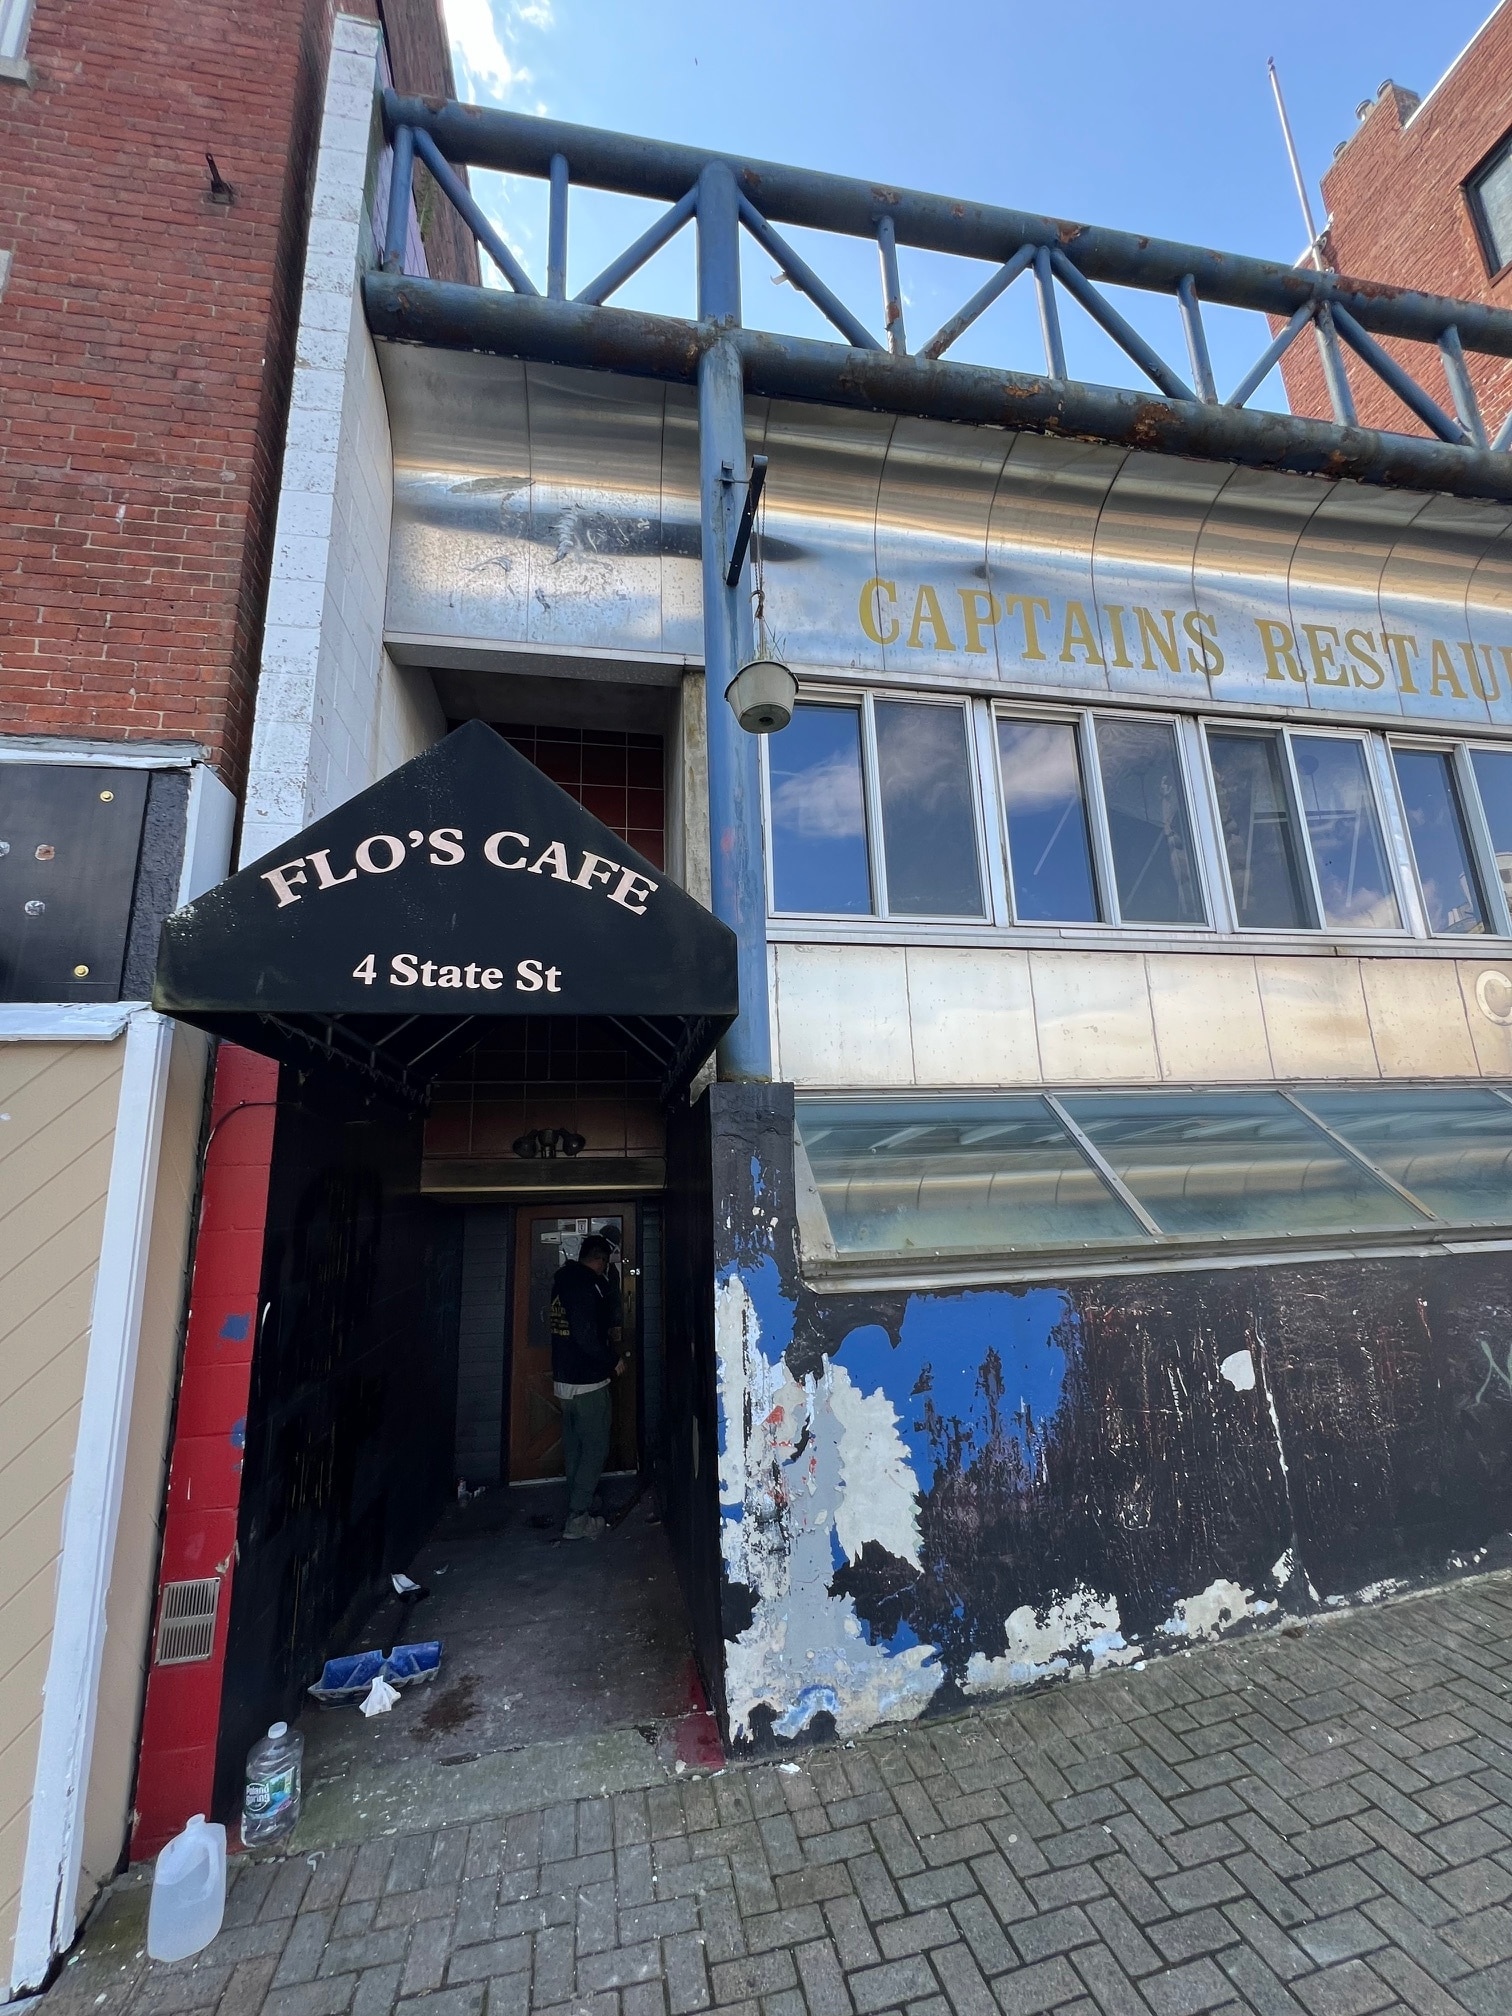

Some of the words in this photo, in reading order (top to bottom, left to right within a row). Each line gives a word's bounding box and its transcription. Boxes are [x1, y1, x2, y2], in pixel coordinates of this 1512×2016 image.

[857, 577, 1225, 676] CAPTAINS
[259, 828, 466, 909] FLO'S
[483, 830, 660, 917] CAFE
[352, 953, 378, 986] 4
[389, 953, 505, 990] State
[515, 958, 563, 993] St
